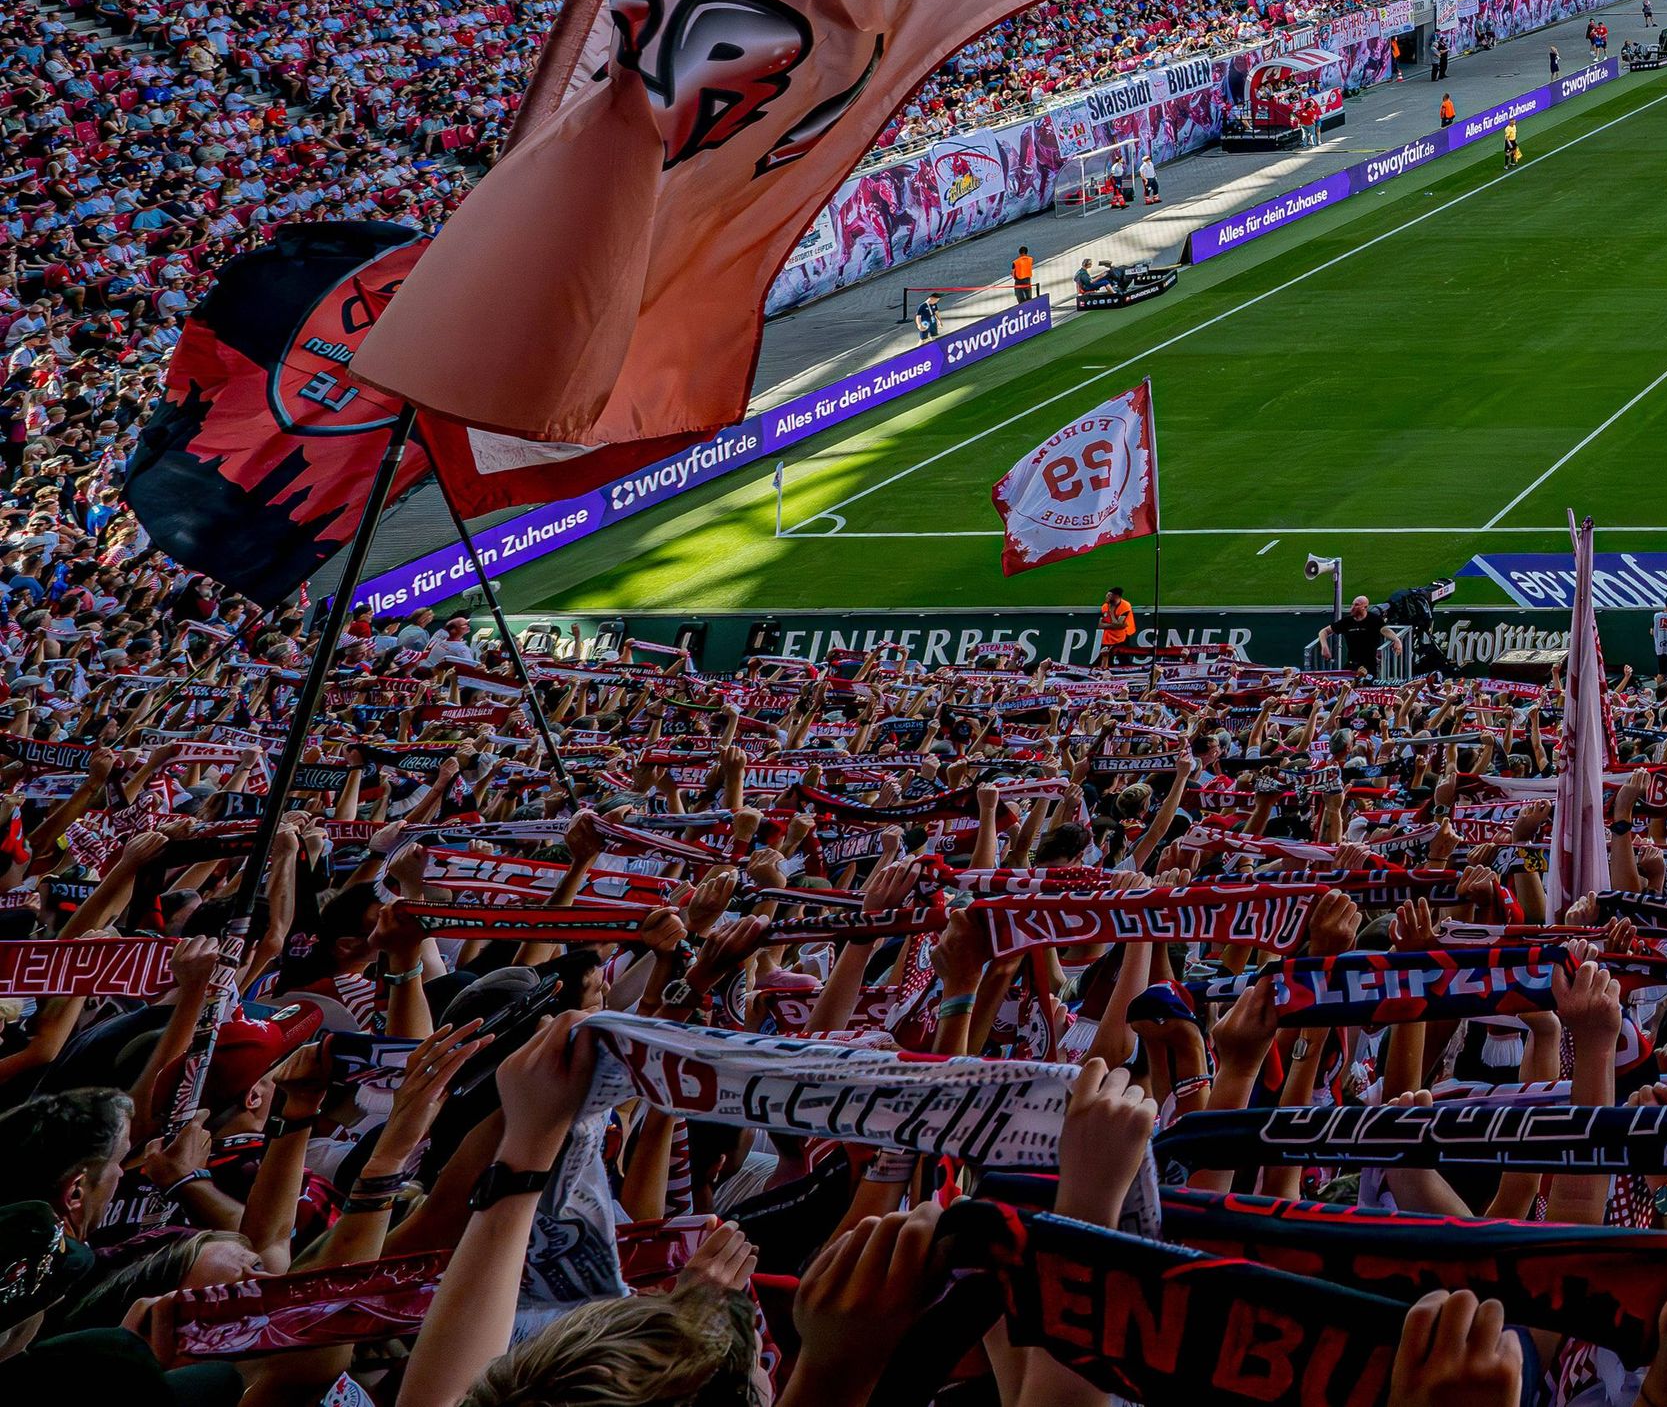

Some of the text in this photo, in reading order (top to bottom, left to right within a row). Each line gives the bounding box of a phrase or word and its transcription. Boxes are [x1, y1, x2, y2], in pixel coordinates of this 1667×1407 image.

[1087, 58, 1211, 121] Skatstadt BULLEN
[1568, 61, 1608, 96] wayfair.de
[1464, 98, 1536, 138] Alles für dein Zuhause
[1378, 142, 1435, 179] wayfair.de
[1218, 189, 1328, 246] Alles für dein Zuhause
[963, 309, 1048, 355] wayfair.de
[775, 360, 932, 435] Alles für dein Zuhause
[635, 433, 757, 496] wayfair.de
[411, 567, 448, 596] für
[501, 506, 590, 560] Zuhause
